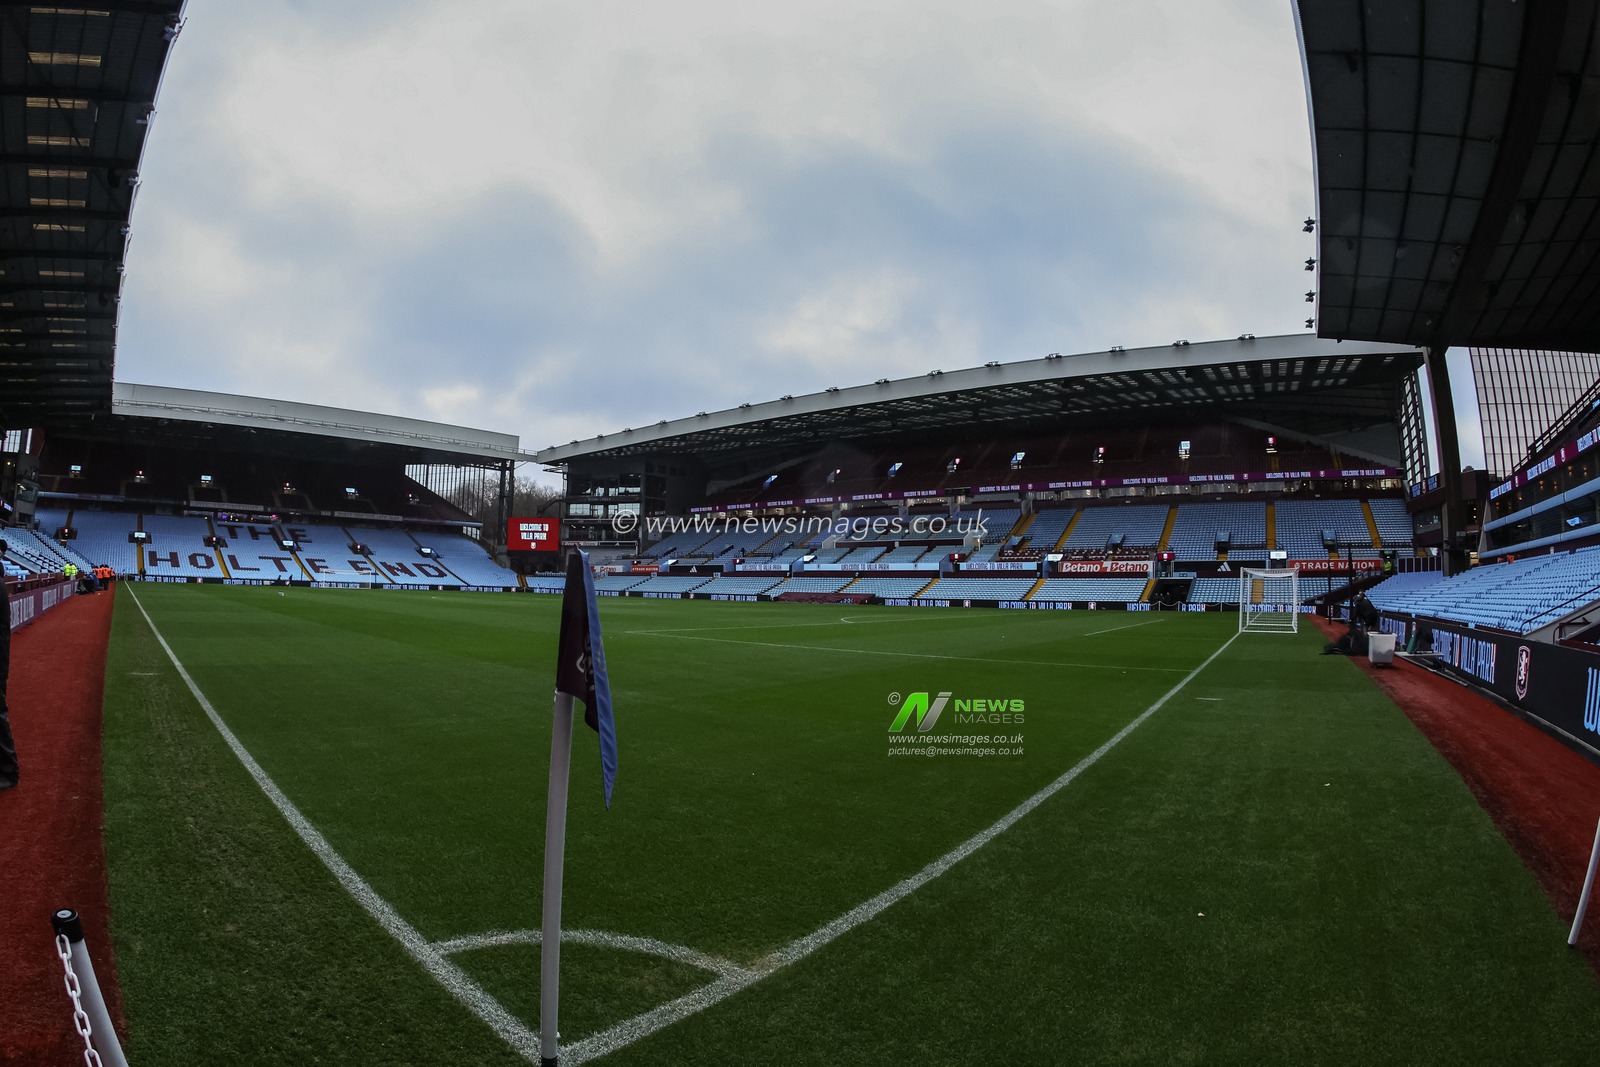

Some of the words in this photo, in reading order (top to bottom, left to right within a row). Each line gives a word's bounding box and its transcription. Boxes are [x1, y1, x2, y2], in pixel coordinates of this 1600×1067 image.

[217, 524, 312, 544] THE
[148, 550, 336, 574] HOLTE
[348, 560, 448, 578] END
[1063, 562, 1100, 572] Betano
[1110, 562, 1148, 572] Betano
[1453, 633, 1460, 667] TO
[1461, 636, 1476, 675] VILLA
[1476, 640, 1496, 684] PARK
